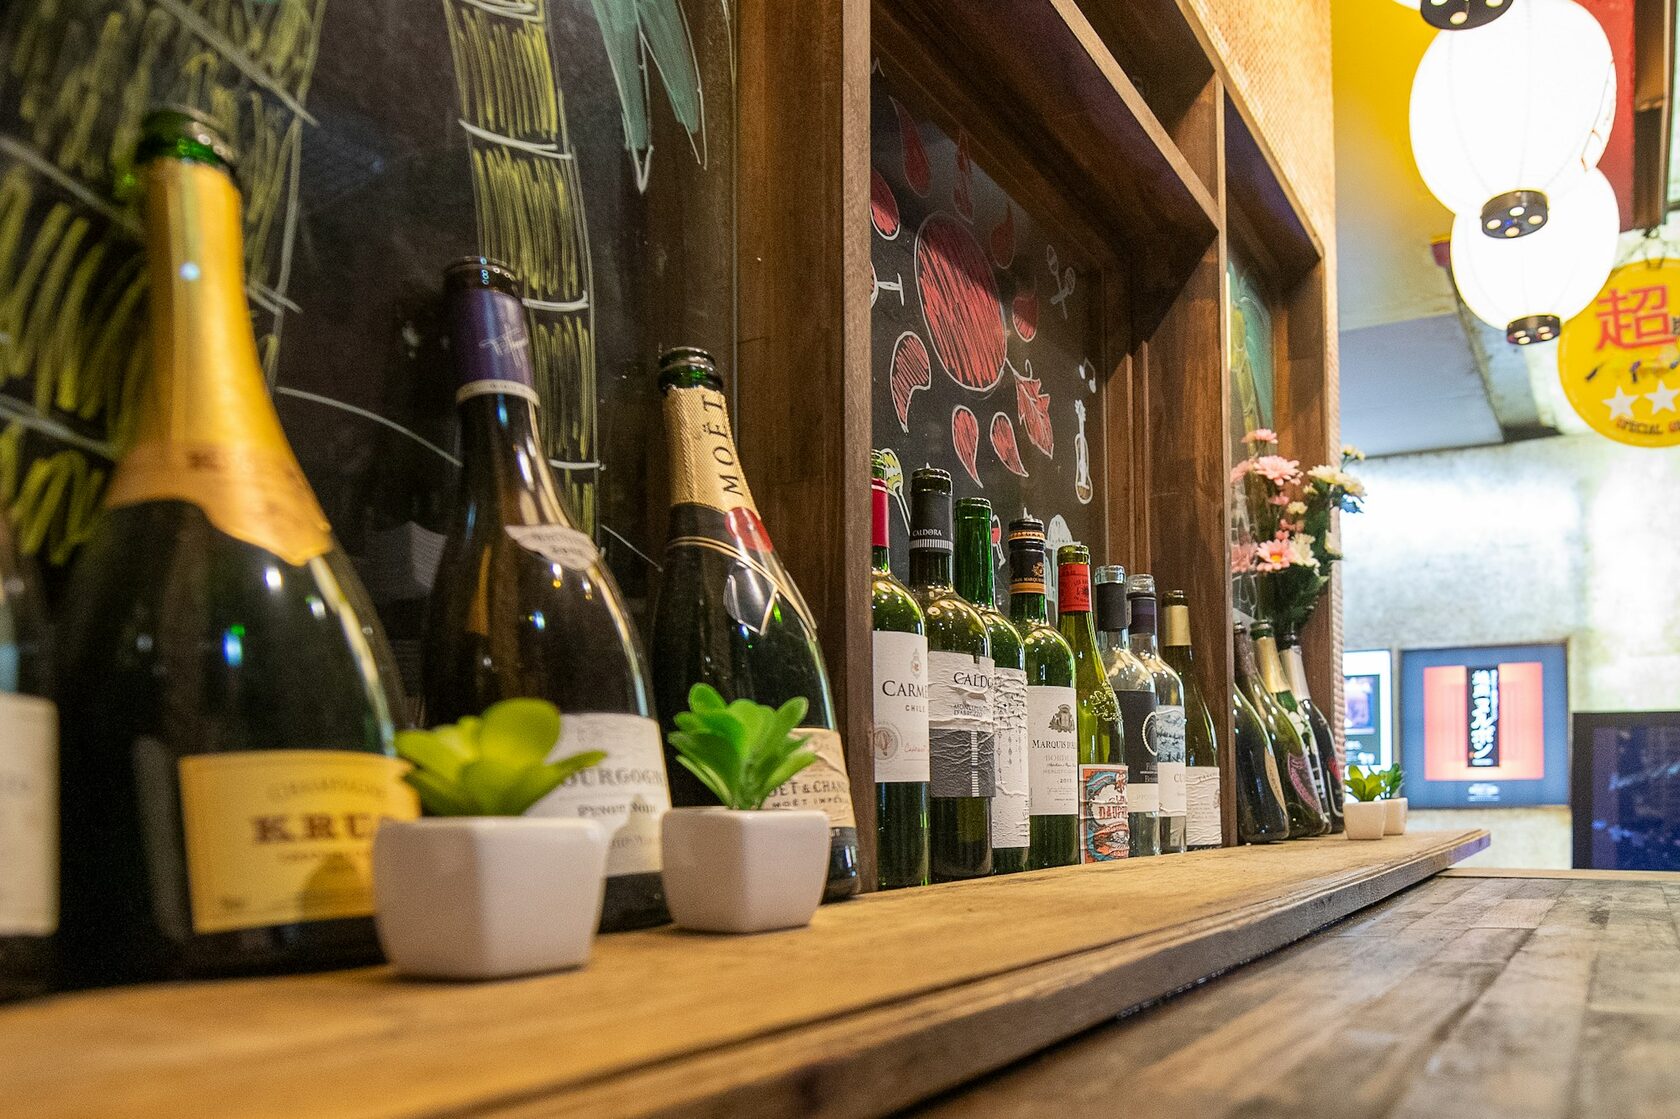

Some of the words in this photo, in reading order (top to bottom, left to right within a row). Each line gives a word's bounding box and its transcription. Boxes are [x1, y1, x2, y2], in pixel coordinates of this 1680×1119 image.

[1595, 285, 1677, 351] 超
[702, 394, 743, 496] MOËT
[912, 528, 943, 537] CALDORA
[882, 680, 928, 699] CARME
[953, 671, 994, 689] CALDO
[1032, 739, 1066, 749] MARQUIS
[251, 811, 384, 844] KRU
